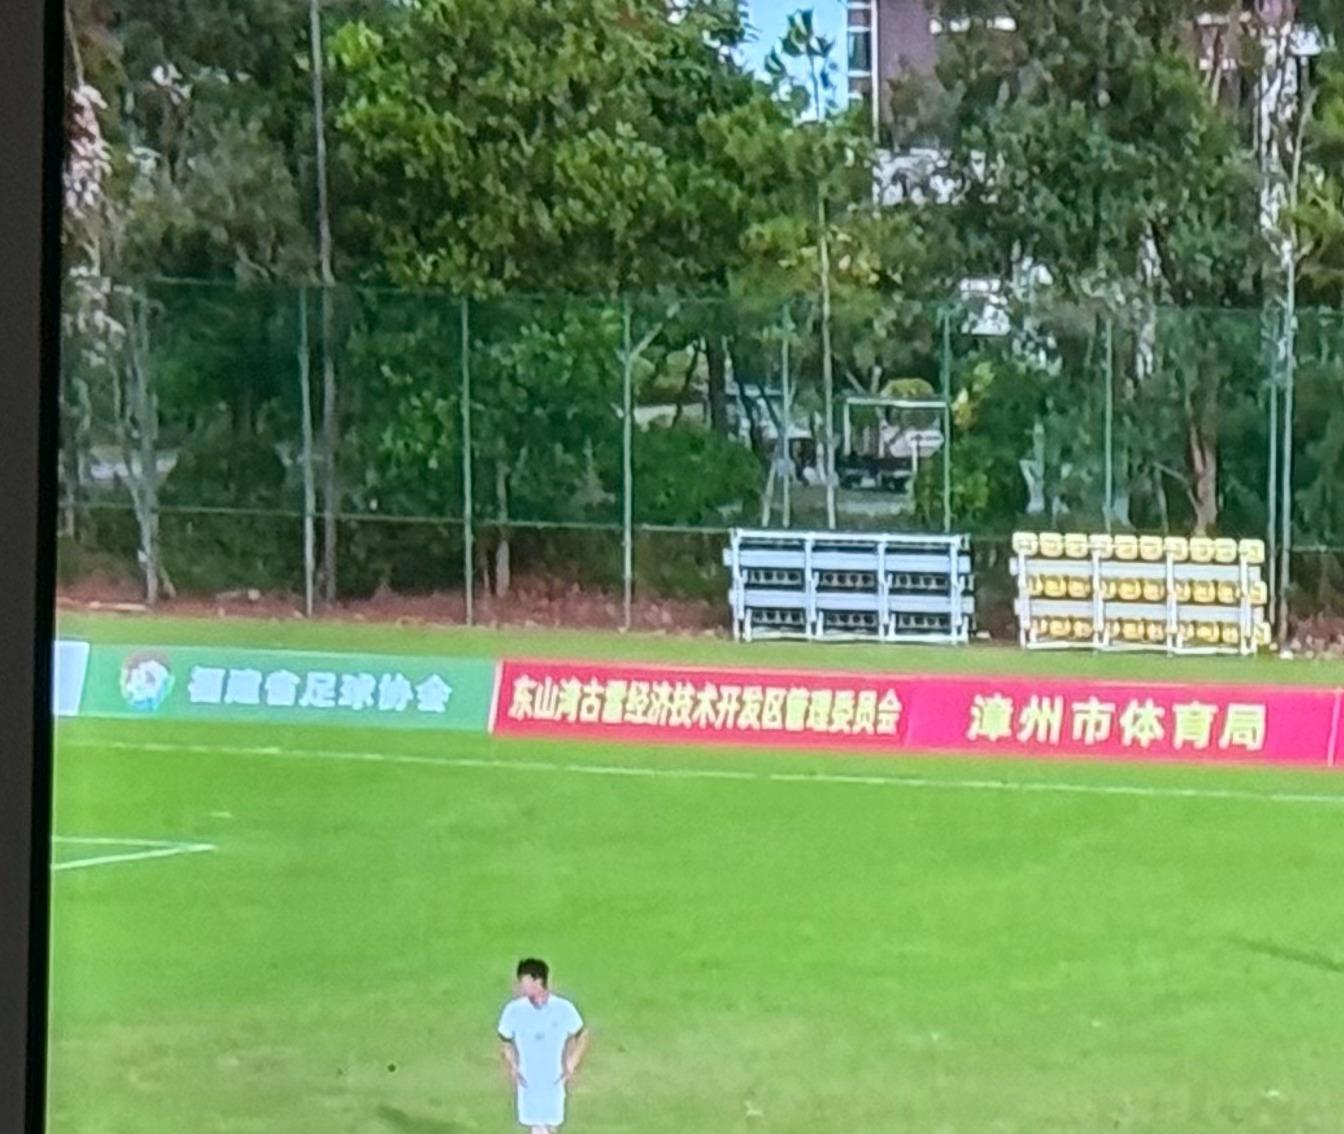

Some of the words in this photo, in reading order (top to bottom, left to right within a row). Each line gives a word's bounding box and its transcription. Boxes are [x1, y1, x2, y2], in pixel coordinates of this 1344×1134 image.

[966, 692, 1267, 751] 漳州市体育局
